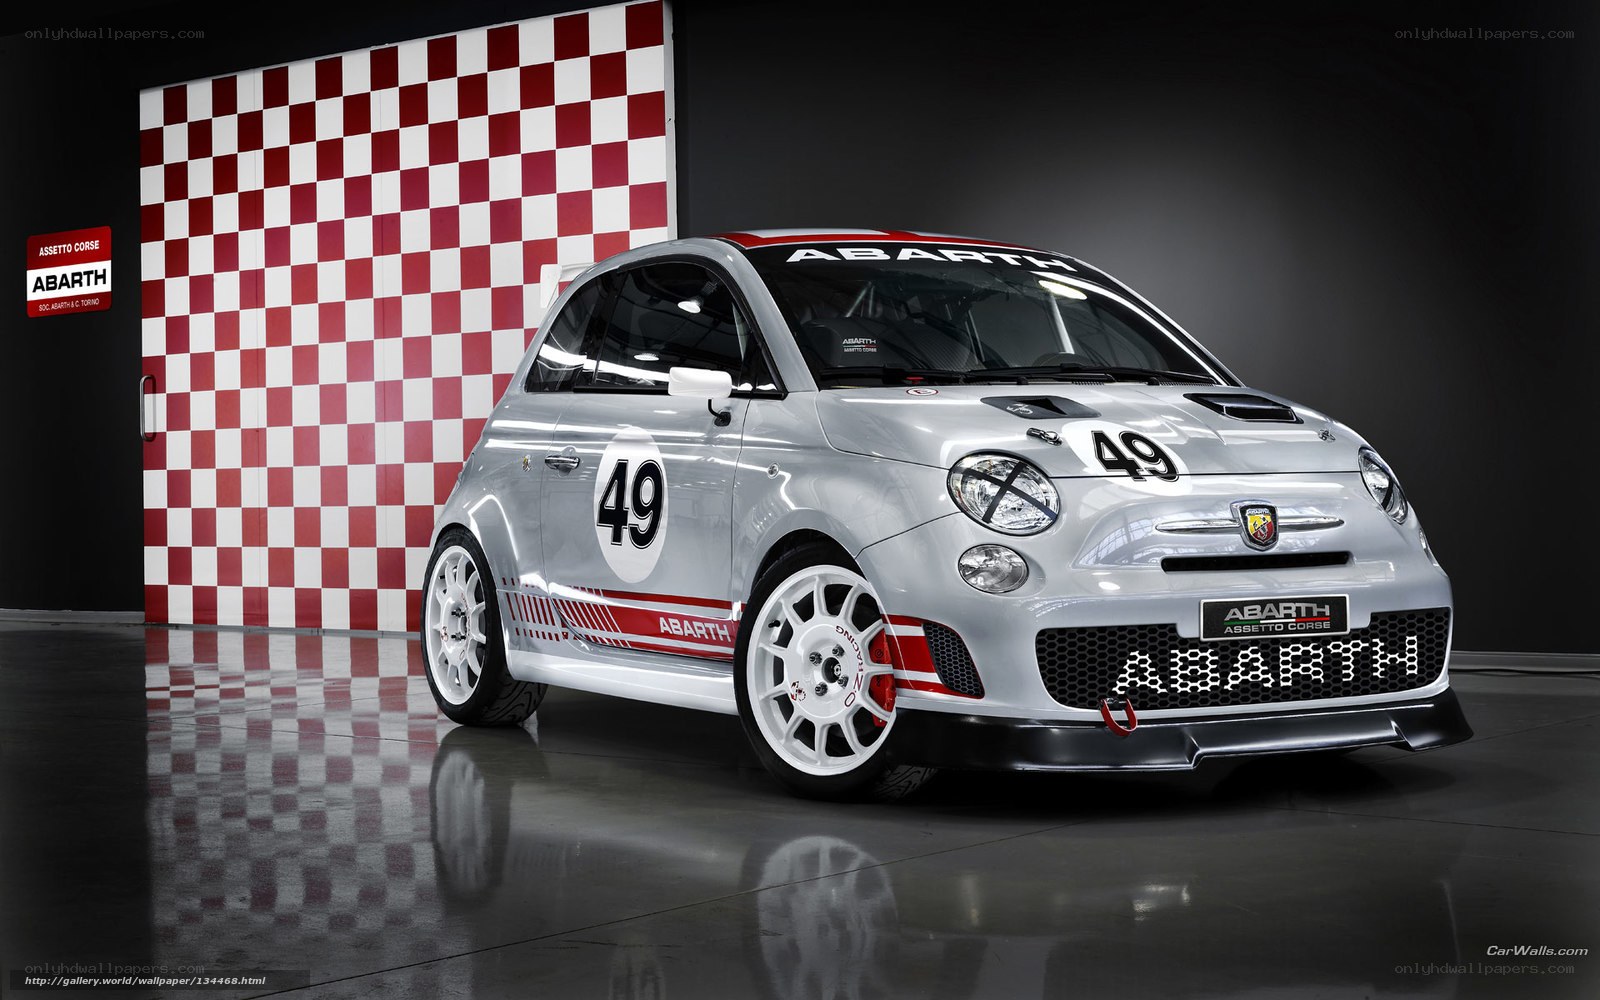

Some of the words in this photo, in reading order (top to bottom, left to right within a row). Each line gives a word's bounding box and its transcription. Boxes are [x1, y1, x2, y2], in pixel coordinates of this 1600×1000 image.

[39, 243, 72, 256] ASSETTO
[74, 240, 100, 252] CORSE
[786, 247, 1078, 272] ABARTH
[32, 268, 106, 292] ABARTH
[51, 301, 70, 310] ABARTH
[81, 298, 100, 306] TORINO
[1091, 430, 1180, 482] 49
[596, 459, 664, 550] 49
[1224, 602, 1330, 620] ABARTH
[659, 616, 731, 642] ABARTH
[1224, 623, 1284, 634] ASSETTO
[1288, 621, 1330, 631] CORSE
[1112, 635, 1419, 694] ABARTH
